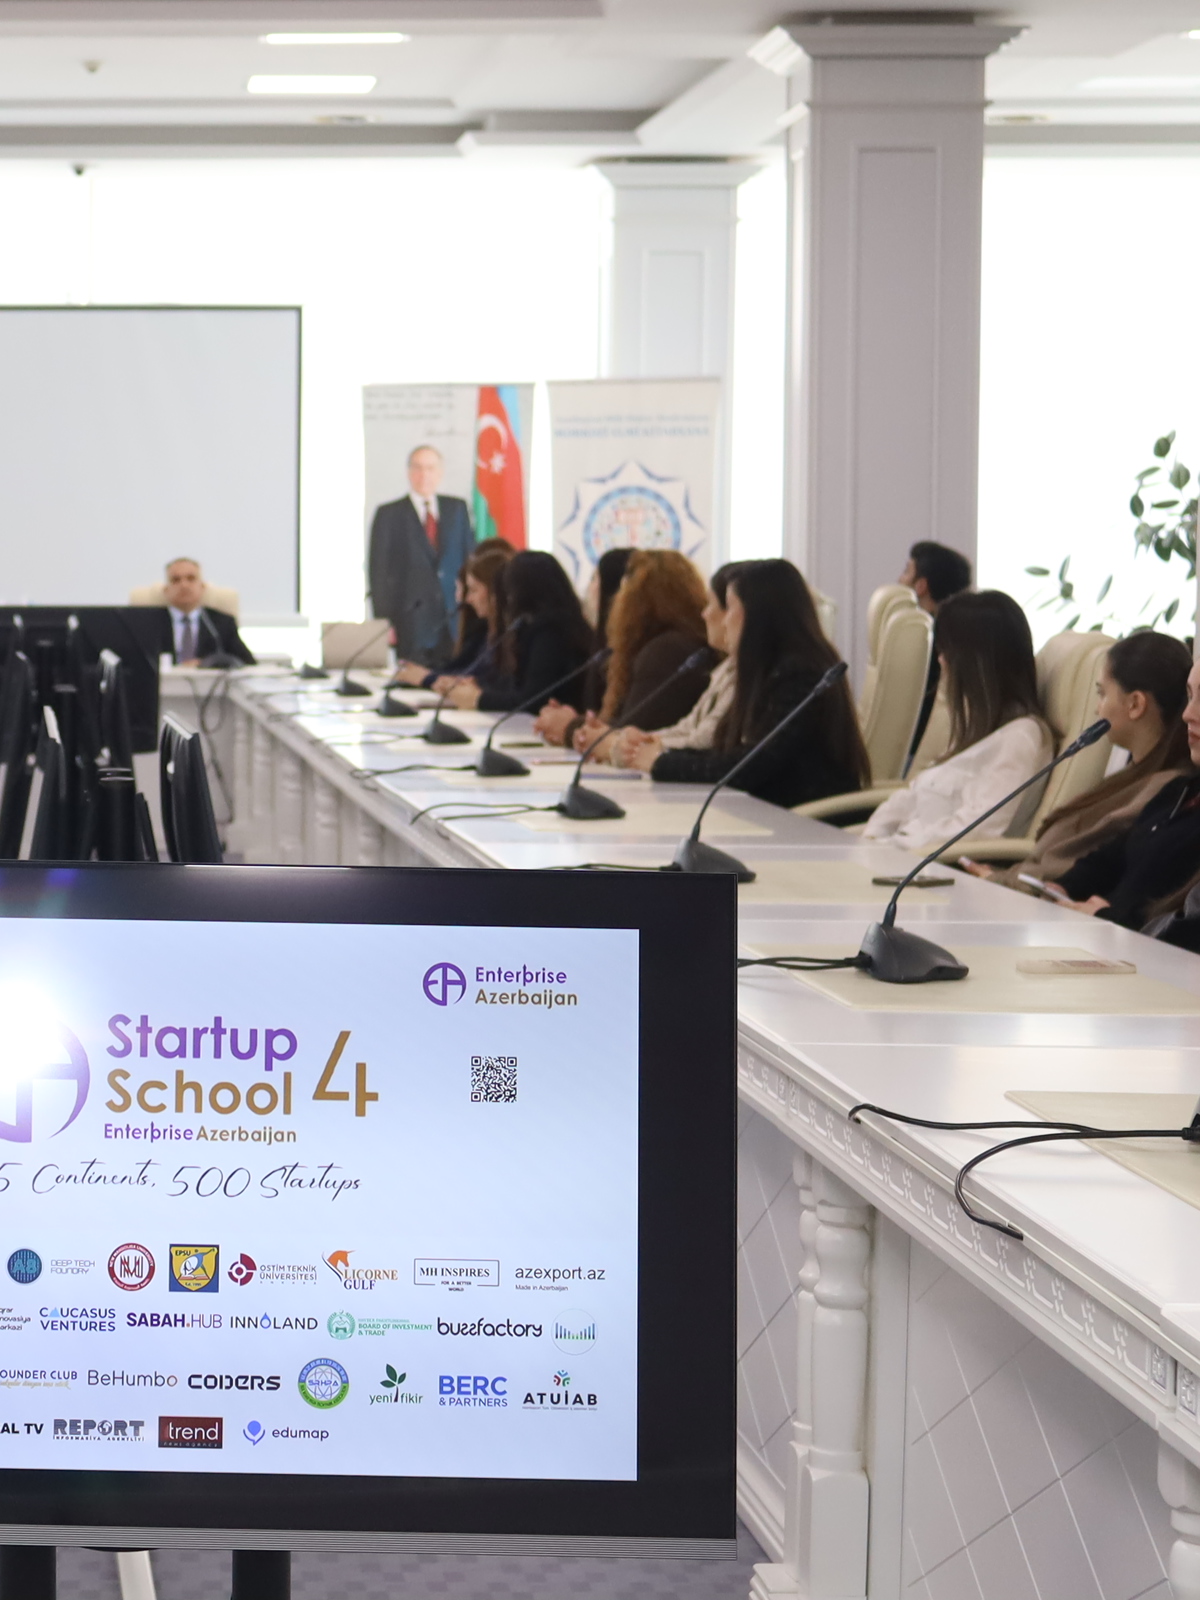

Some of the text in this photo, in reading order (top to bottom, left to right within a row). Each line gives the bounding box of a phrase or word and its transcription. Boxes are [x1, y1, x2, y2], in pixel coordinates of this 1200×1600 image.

[475, 964, 567, 987] Enterprise
[475, 989, 578, 1009] Azerbaijan
[105, 1013, 298, 1071] Startup
[105, 1030, 379, 1117] School 4
[104, 1121, 297, 1145] Enterprise Azerbaijan
[32, 1158, 158, 1195] Continents,
[166, 1164, 252, 1198] 500
[259, 1161, 362, 1202] Startups
[50, 1259, 96, 1268] DEEP TECH
[259, 1264, 317, 1273] OSTİM TEKNİK
[50, 1267, 90, 1275] FOUNDRY
[259, 1271, 318, 1281] ÜNİVERSİTESİ
[343, 1268, 399, 1281] LICORNE
[419, 1267, 490, 1277] MH INSPIRES
[514, 1265, 606, 1283] azexport.az
[343, 1279, 377, 1290] GULF
[538, 1284, 569, 1292] Azerbaijan
[40, 1320, 116, 1332] VENTURES
[126, 1311, 223, 1328] SABAH.HUB
[392, 1323, 433, 1331] INVESTMENT
[50, 1369, 78, 1381] CLUB
[88, 1369, 179, 1388] BeHumbo
[438, 1375, 508, 1396] BERC
[400, 1392, 423, 1404] fikir
[438, 1397, 508, 1408] & PARTNERS
[523, 1390, 598, 1406] ATUİAB
[24, 1423, 44, 1435] TV
[53, 1418, 145, 1437] REPORT
[168, 1421, 219, 1440] trend
[272, 1426, 330, 1442] edumap
